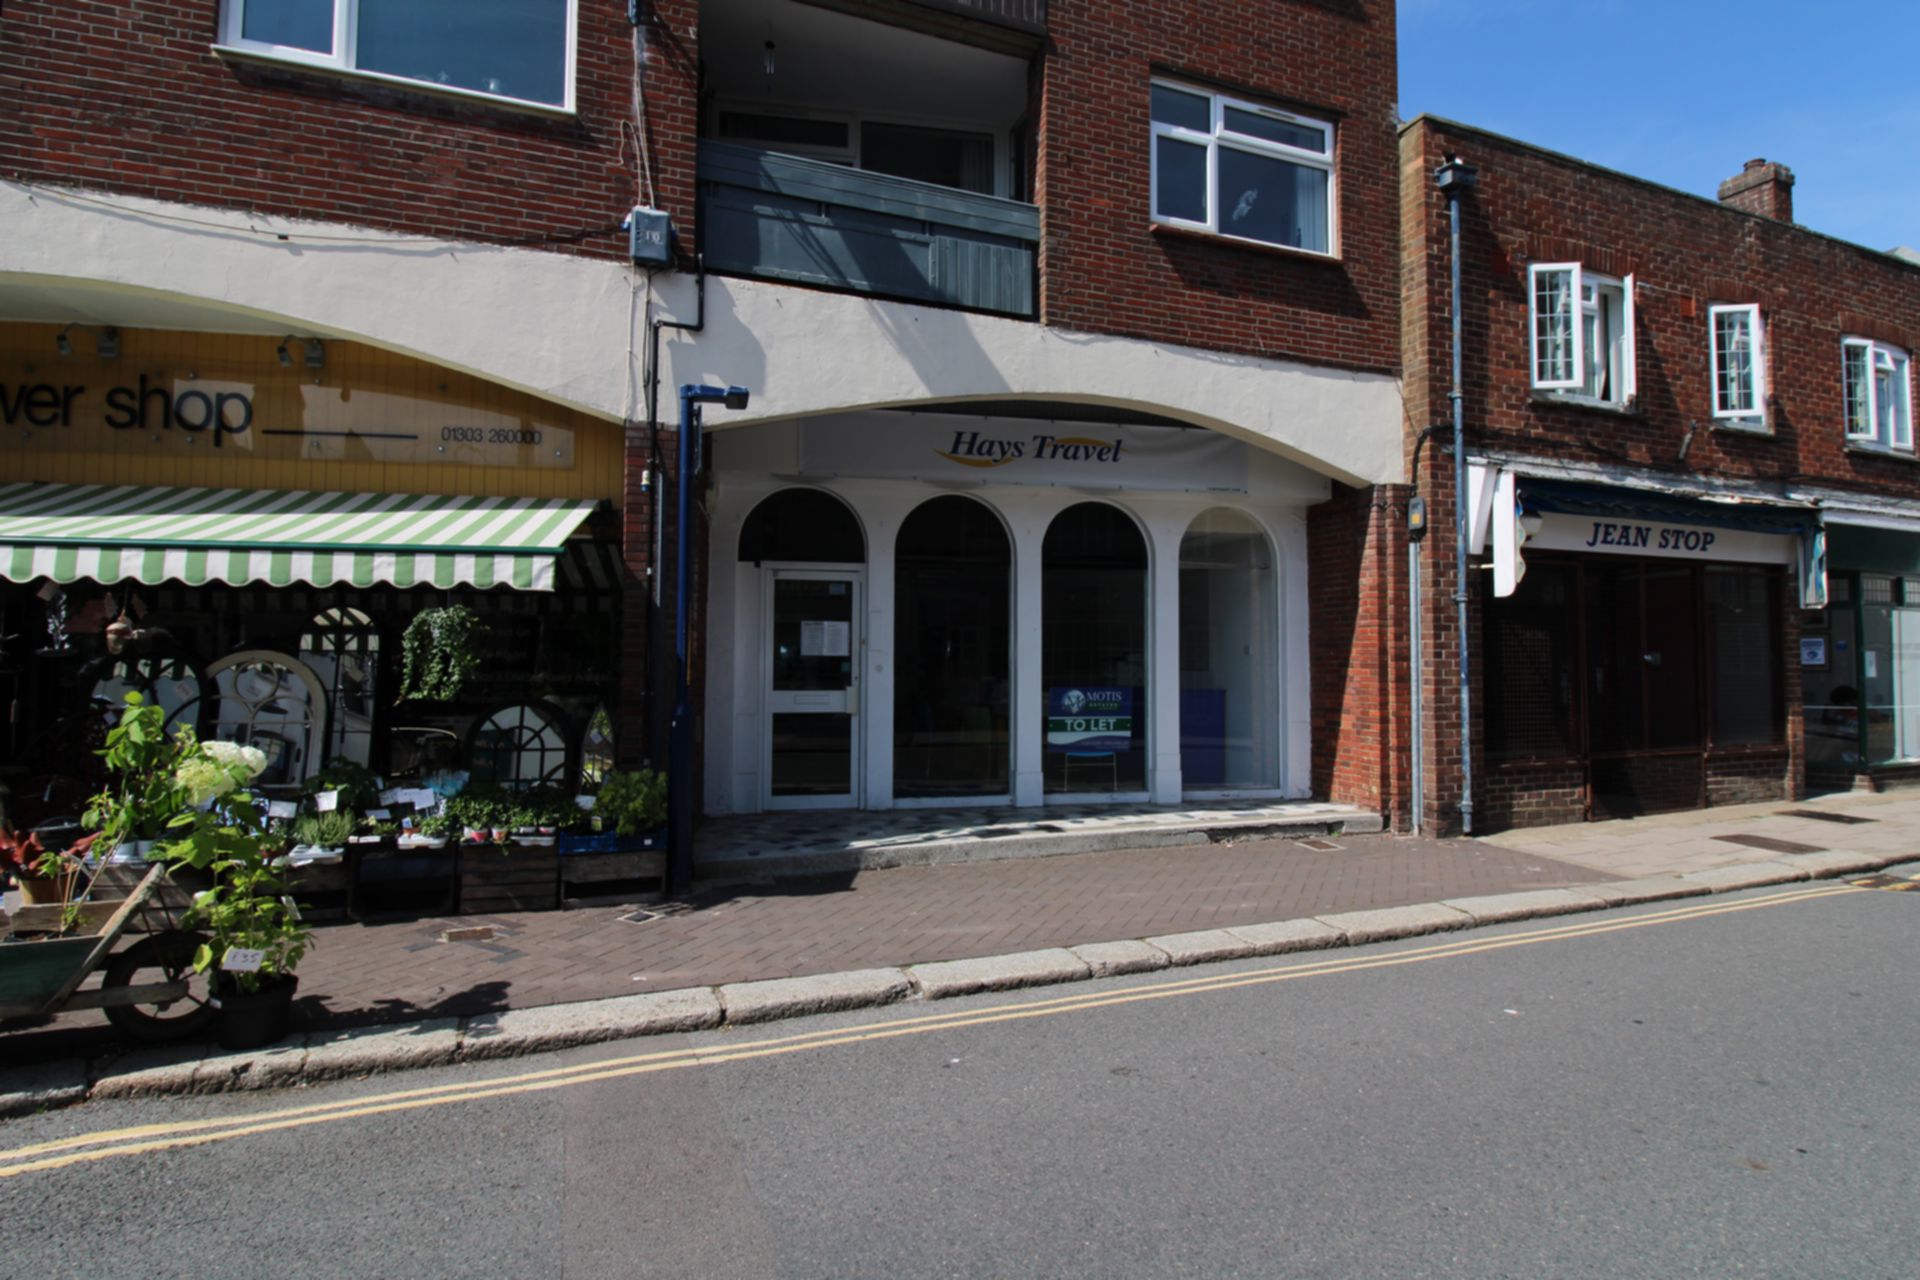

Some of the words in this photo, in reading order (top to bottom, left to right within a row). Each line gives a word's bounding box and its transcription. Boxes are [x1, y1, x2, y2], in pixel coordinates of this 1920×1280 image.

[104, 374, 253, 447] shop
[441, 426, 483, 443] 01303
[488, 429, 542, 446] 260000
[949, 431, 1025, 462] Hays
[1032, 435, 1122, 462] Travel
[1586, 523, 1652, 547] JEAN
[1658, 528, 1715, 551] STOP
[1086, 691, 1122, 701] MOTIS
[1064, 719, 1086, 731] TO
[1091, 719, 1116, 731] LET
